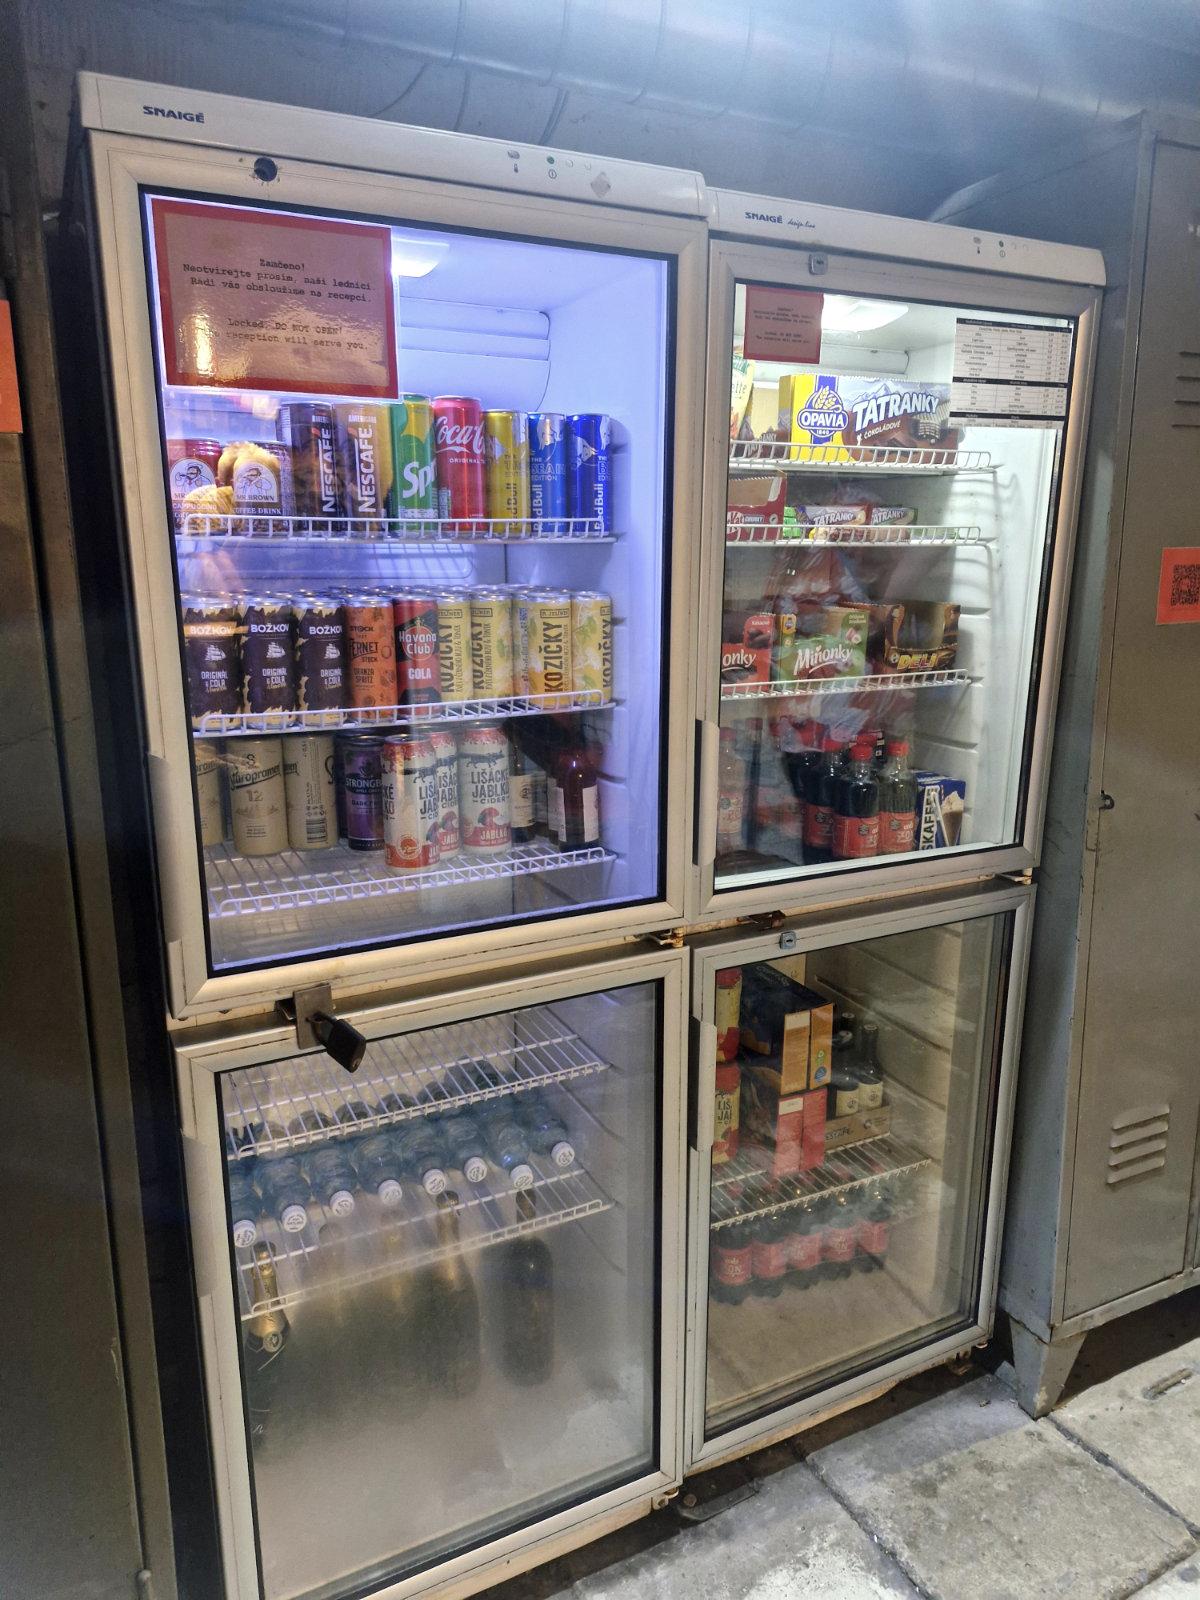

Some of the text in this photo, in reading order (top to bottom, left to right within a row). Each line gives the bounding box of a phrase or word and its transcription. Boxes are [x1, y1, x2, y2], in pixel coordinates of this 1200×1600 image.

[310, 289, 322, 298] na
[852, 393, 939, 432] TATRANKY
[800, 411, 845, 428] OPAVIA
[258, 507, 282, 515] DRINK
[813, 511, 854, 526] TATRANKY
[250, 622, 290, 634] BOŽKOV
[398, 630, 437, 642] Havana
[406, 643, 431, 654] Club
[538, 621, 564, 693] KOZIČKY
[896, 653, 939, 670] DELI
[407, 667, 432, 680] COLA
[209, 679, 226, 688] COLA
[270, 676, 286, 685] COLA
[246, 790, 264, 802] 12
